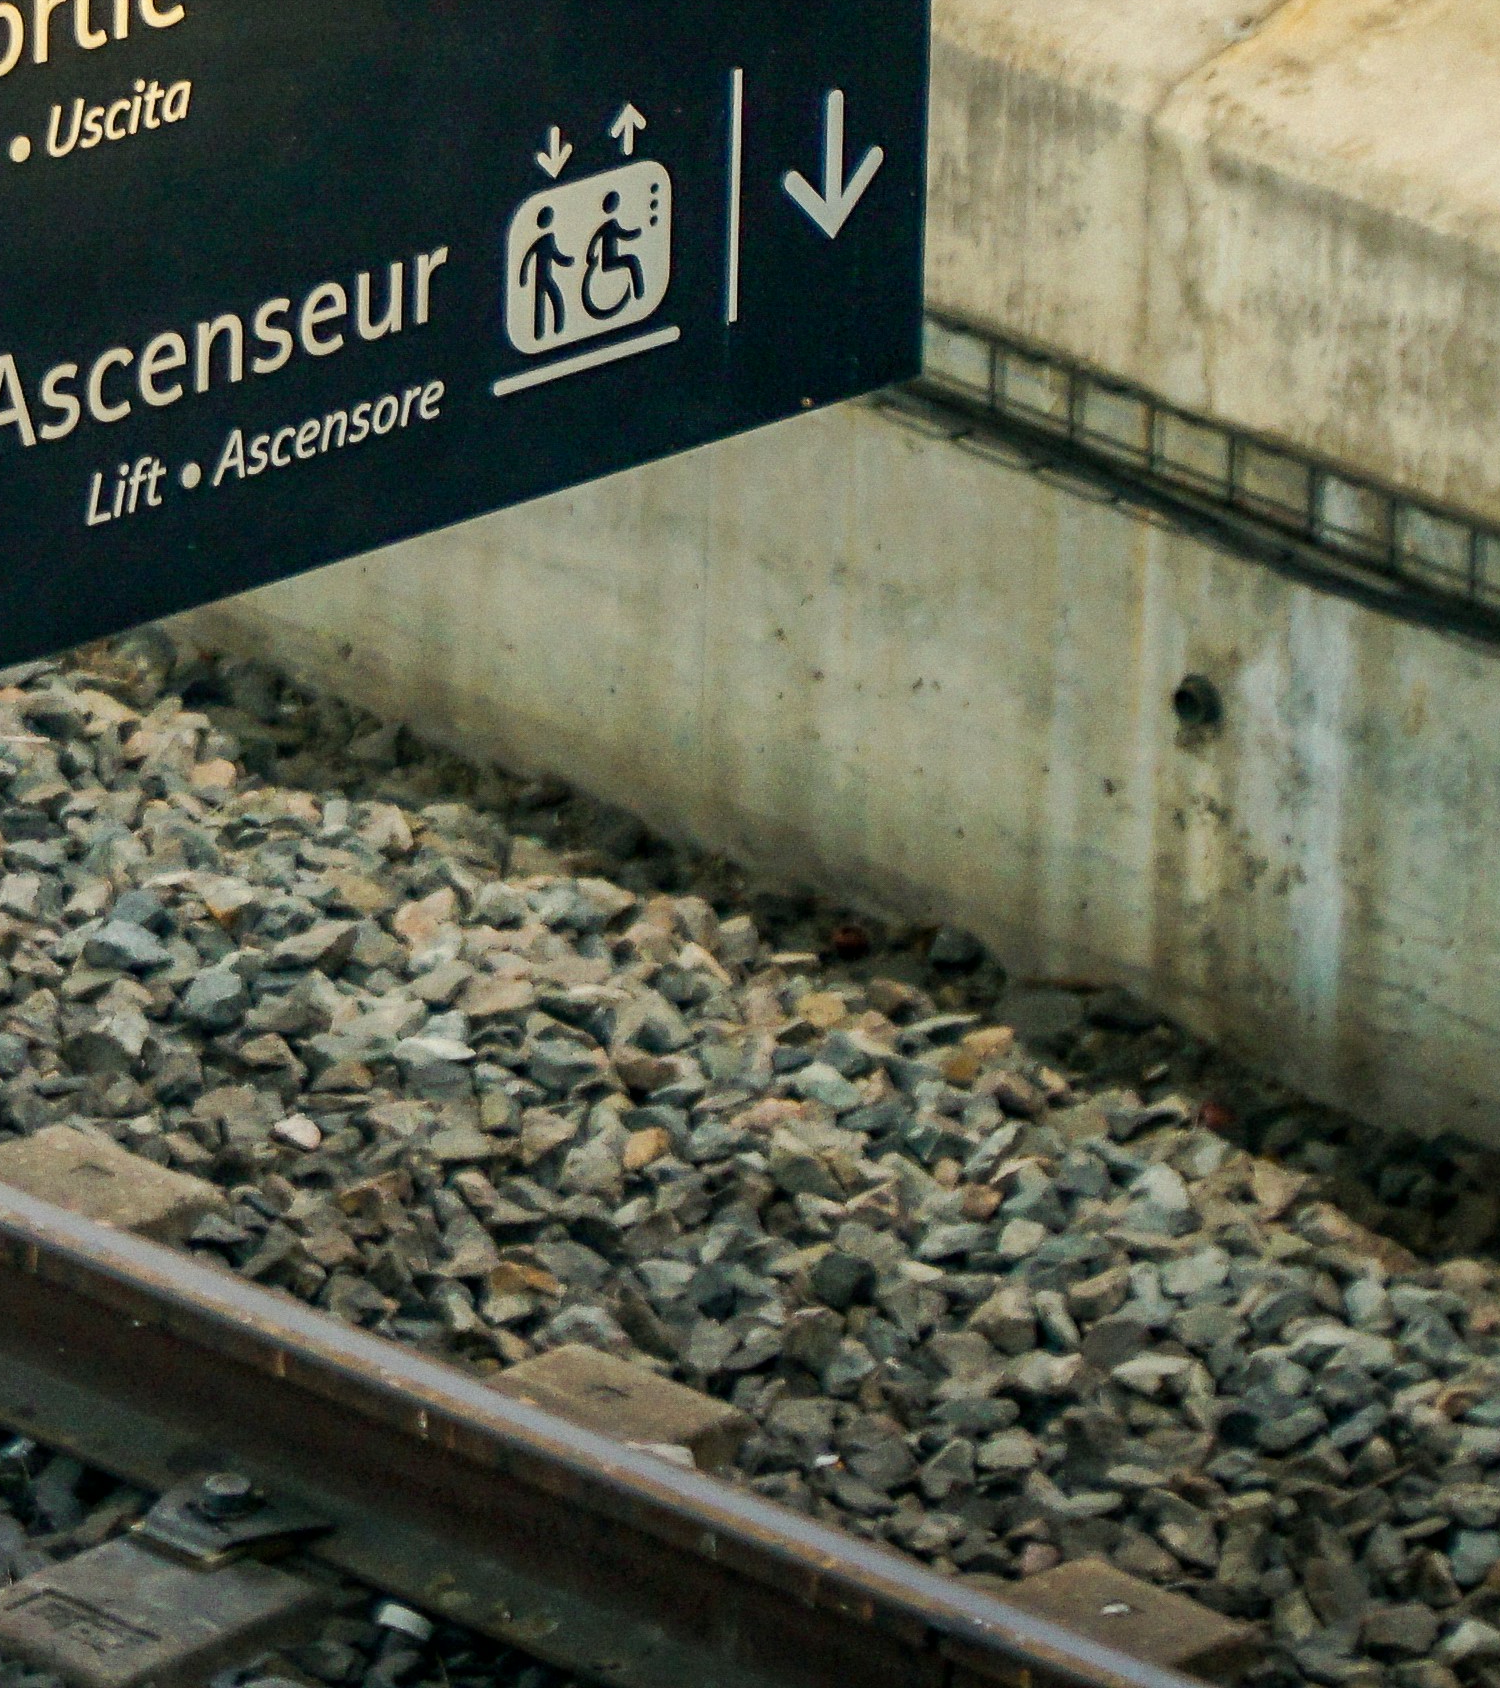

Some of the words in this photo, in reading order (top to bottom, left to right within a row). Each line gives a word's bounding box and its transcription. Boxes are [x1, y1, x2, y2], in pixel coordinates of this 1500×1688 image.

[44, 77, 193, 159] Uscita
[85, 455, 168, 528] Lift
[211, 379, 446, 488] Ascensore
